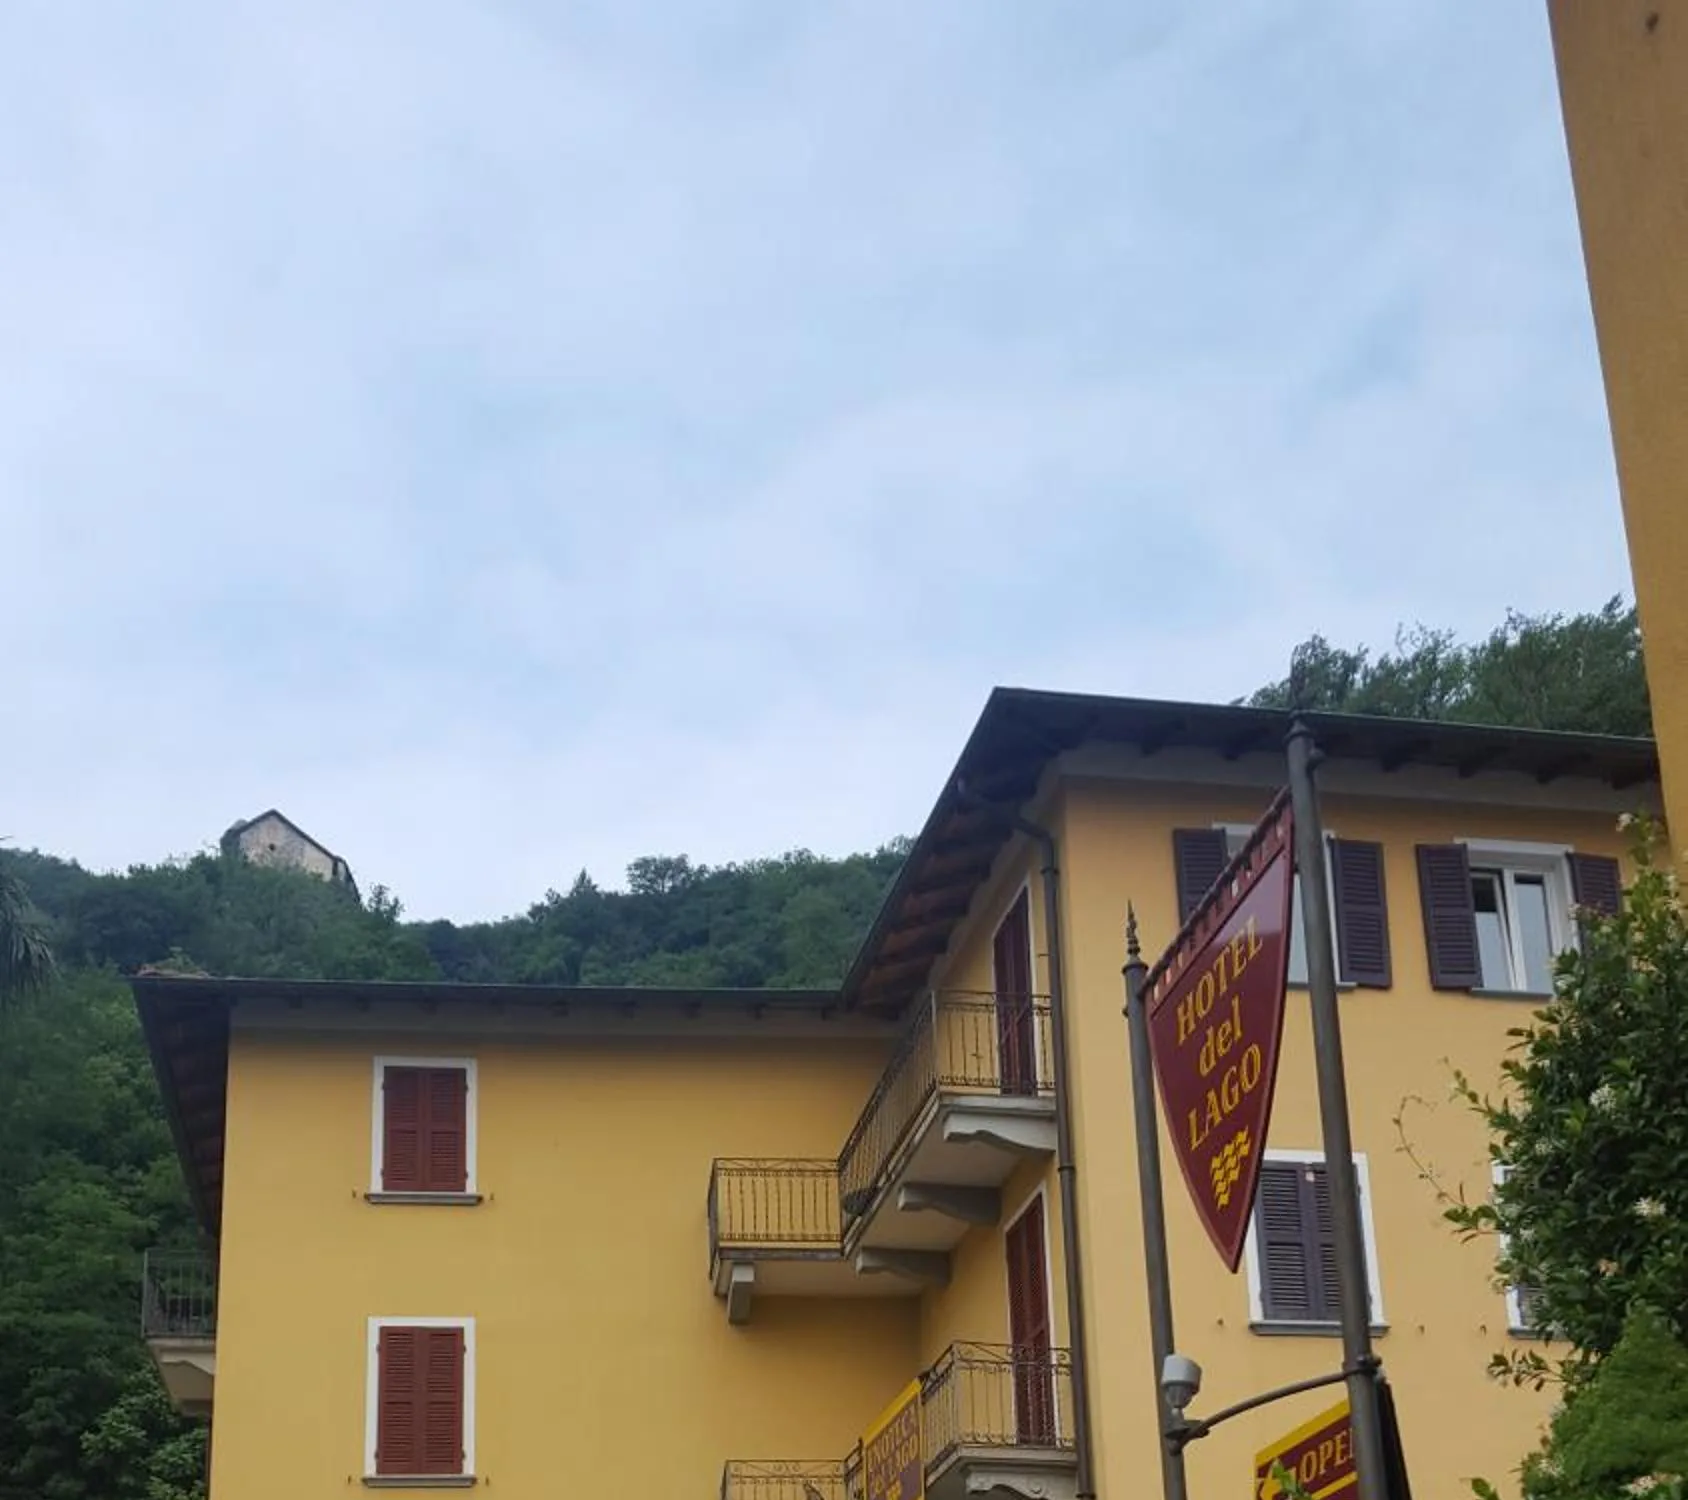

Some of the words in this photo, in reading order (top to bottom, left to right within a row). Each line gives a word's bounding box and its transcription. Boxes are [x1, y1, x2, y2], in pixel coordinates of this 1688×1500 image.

[1176, 916, 1263, 1045] HOTEL
[1199, 994, 1243, 1077] del
[1187, 1043, 1261, 1150] LAGO
[1301, 1427, 1353, 1483] OPE
